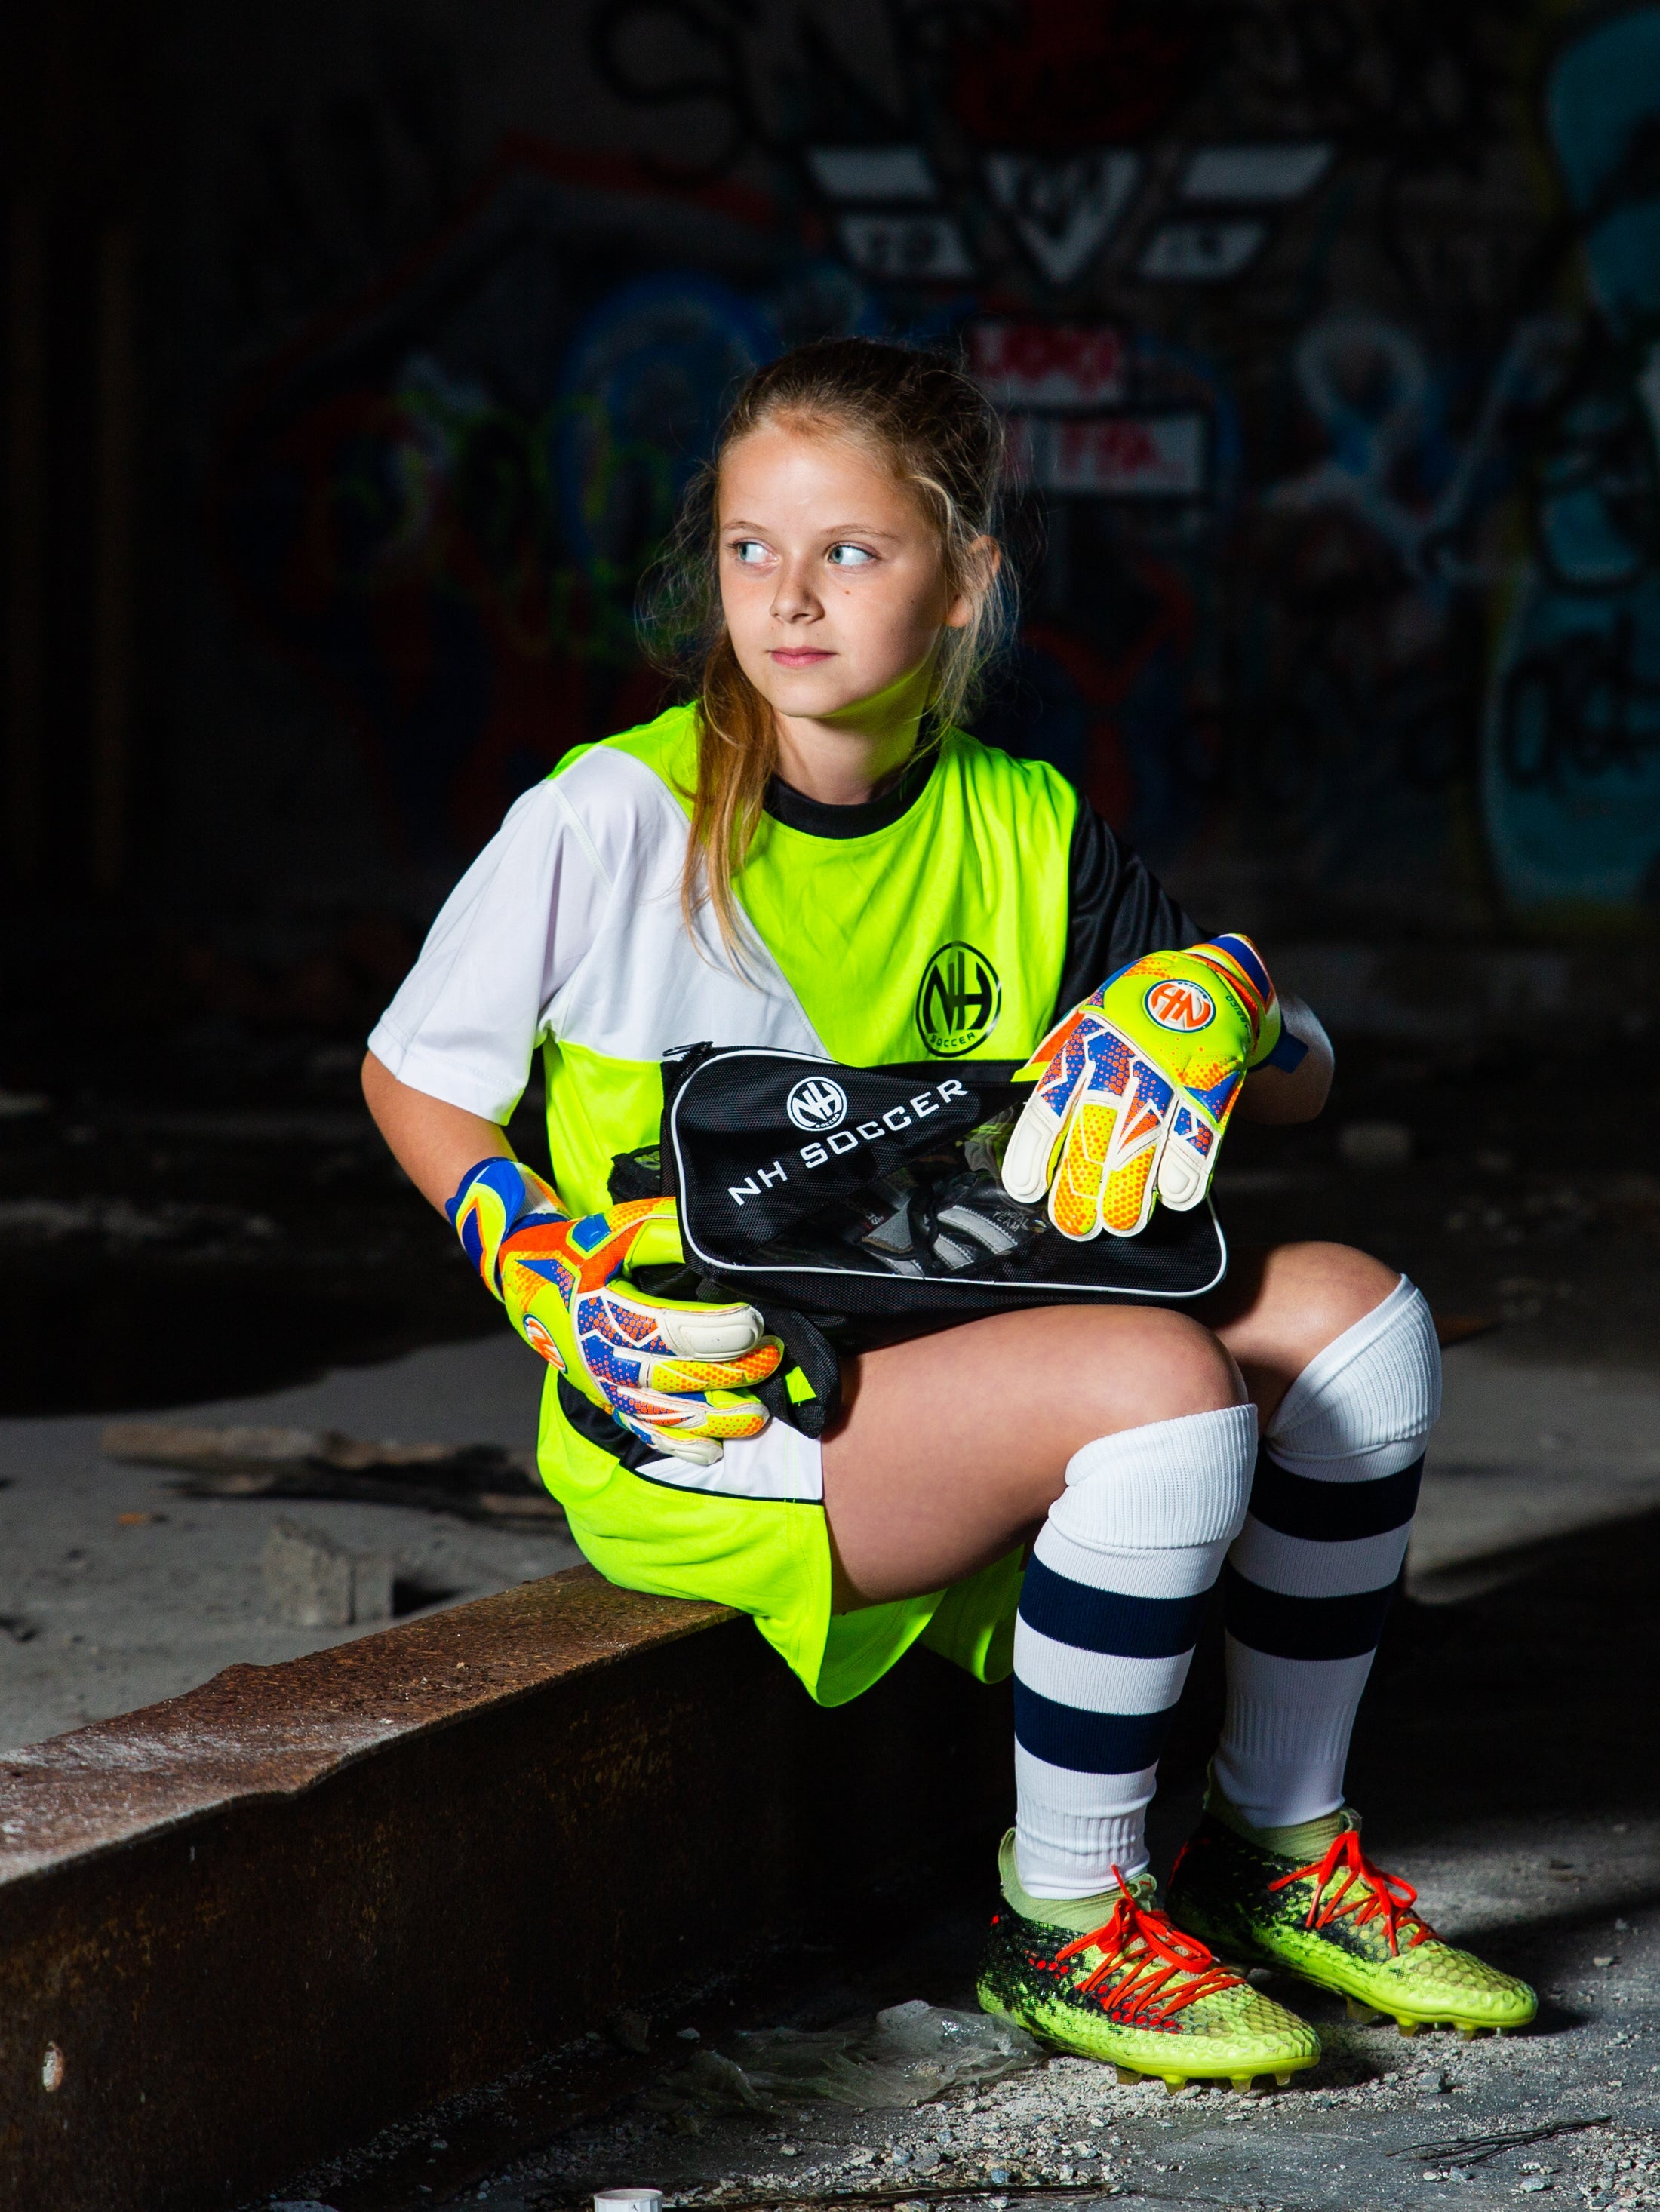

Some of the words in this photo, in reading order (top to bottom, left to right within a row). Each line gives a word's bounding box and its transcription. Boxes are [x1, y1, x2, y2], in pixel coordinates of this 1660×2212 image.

[923, 950, 993, 1036] NH
[929, 1031, 976, 1048] SOCCER
[792, 1081, 842, 1127] NH
[815, 1113, 841, 1129] SOCCER
[727, 1160, 788, 1206] NH
[800, 1079, 969, 1169] SOCCER
[992, 1210, 1020, 1232] TEAM
